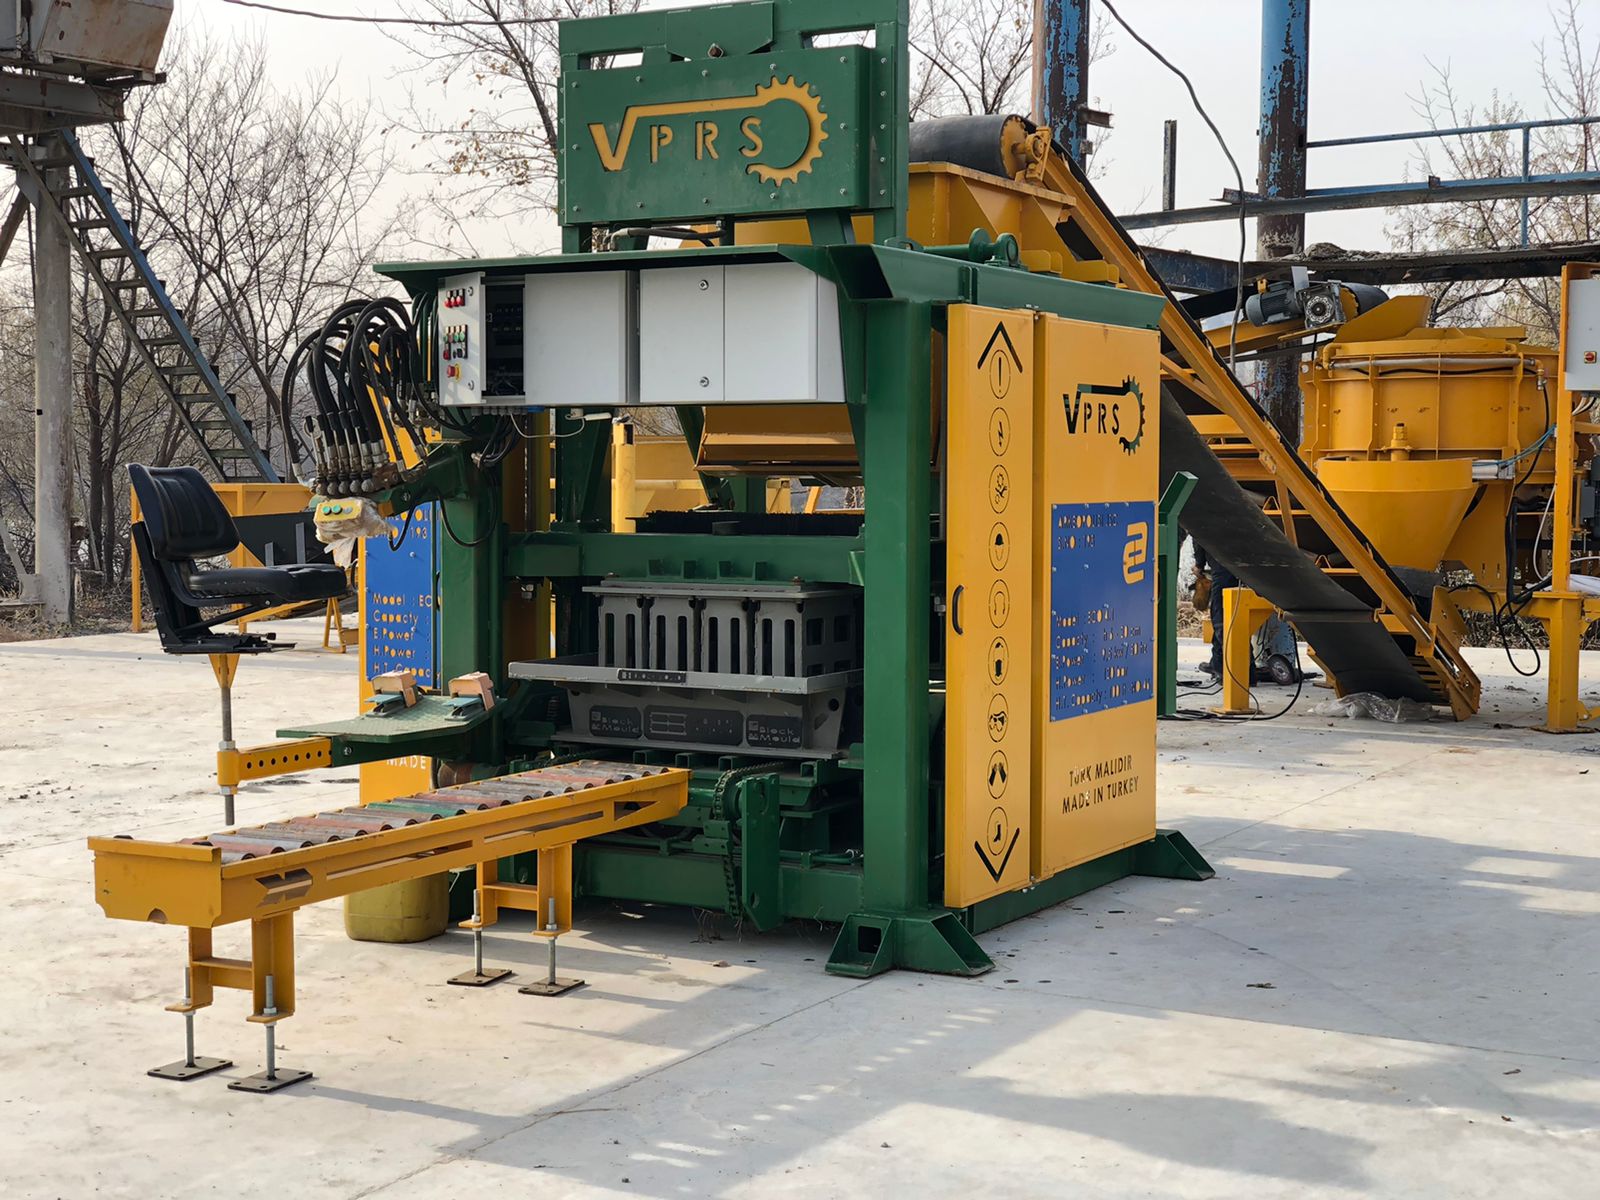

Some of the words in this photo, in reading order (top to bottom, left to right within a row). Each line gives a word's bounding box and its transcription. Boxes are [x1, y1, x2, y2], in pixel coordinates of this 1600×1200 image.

[373, 591, 405, 606] Model
[418, 594, 441, 608] EC
[1056, 614, 1079, 628] Model
[602, 716, 633, 726] Block
[602, 724, 639, 734] Mould
[759, 726, 794, 736] Block
[759, 734, 800, 744] Mould
[1062, 791, 1091, 814] MADE
[1093, 786, 1104, 805] IN
[1107, 776, 1139, 801] TURKEY
